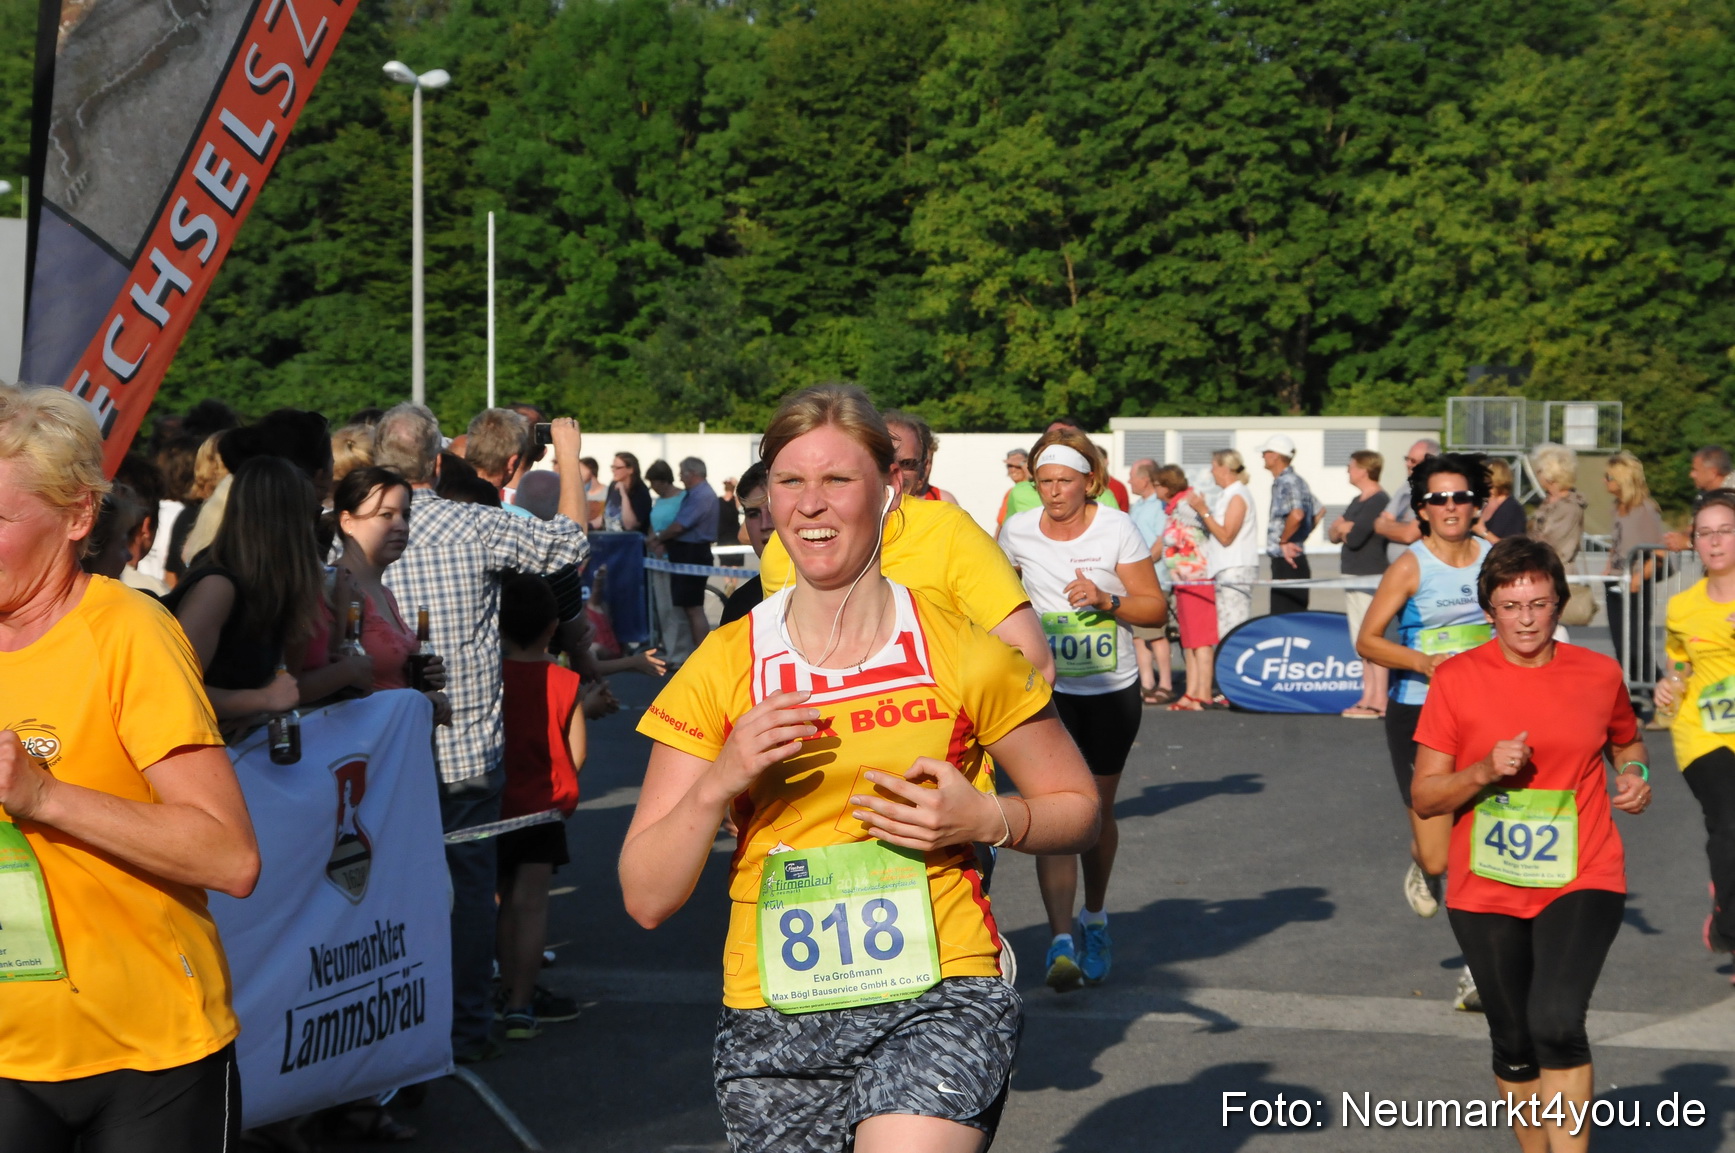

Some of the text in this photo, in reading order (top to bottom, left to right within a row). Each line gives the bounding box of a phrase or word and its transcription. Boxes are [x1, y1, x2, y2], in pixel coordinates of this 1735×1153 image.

[1048, 633, 1113, 660] 1016
[851, 698, 949, 734] BÖGL
[1484, 820, 1560, 862] 492
[776, 872, 834, 890] firmenlauf
[779, 897, 905, 972] 818
[15, 957, 42, 967] GmbH
[308, 918, 406, 992] Neumarkter
[771, 973, 931, 1001] Max Bögl Bauservice GmbH & Co. KG
[813, 967, 883, 983] Eva Großmann
[279, 968, 426, 1075] Lammsbräu
